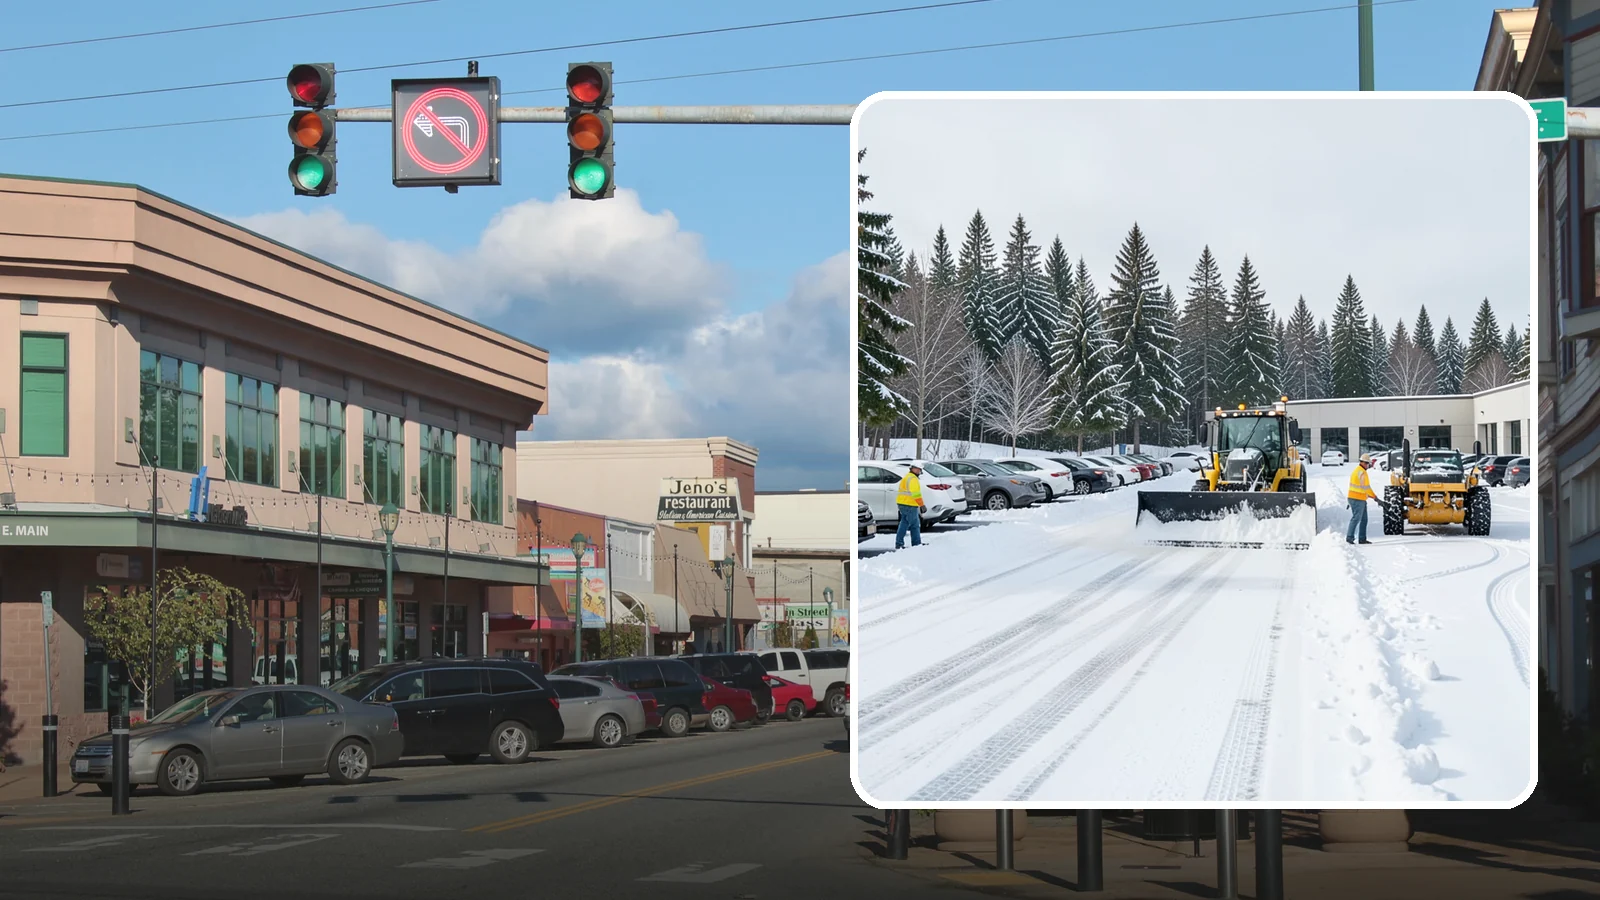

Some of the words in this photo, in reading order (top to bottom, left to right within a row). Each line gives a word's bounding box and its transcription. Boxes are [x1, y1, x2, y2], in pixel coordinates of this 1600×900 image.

[669, 480, 728, 495] Jeno's
[665, 496, 731, 509] restaurant
[658, 510, 682, 519] Italian
[686, 510, 715, 519] American
[714, 509, 737, 519] Cuisine
[2, 525, 13, 536] E.
[15, 525, 49, 536] MAIN
[797, 607, 828, 617] Street
[789, 619, 823, 627] lass
